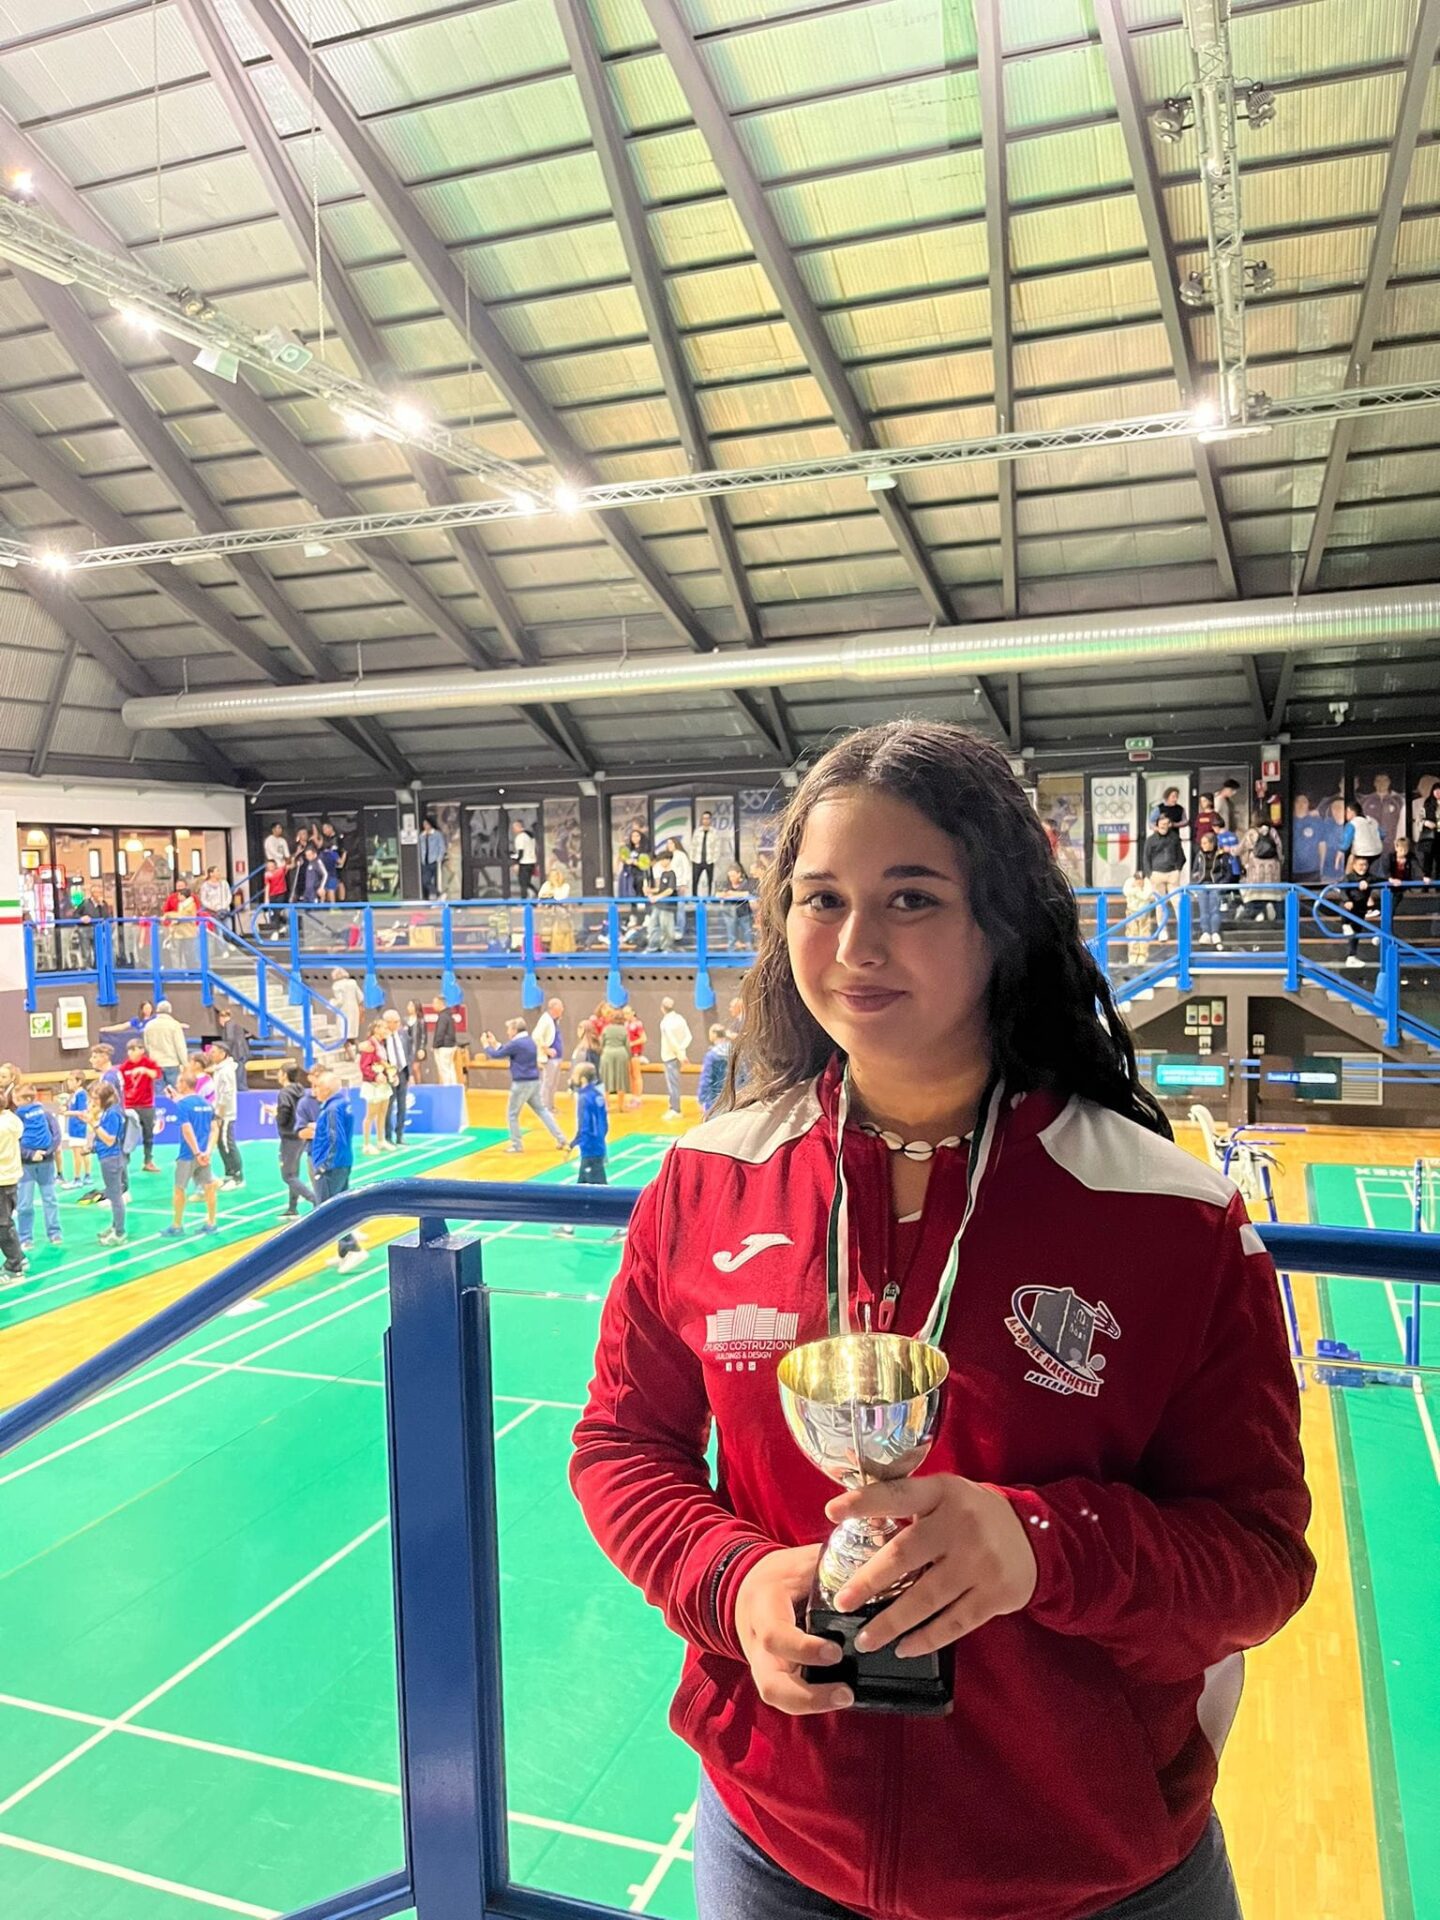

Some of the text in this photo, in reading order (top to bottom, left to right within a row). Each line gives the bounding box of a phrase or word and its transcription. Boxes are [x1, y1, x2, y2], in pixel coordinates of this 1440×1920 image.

[1094, 784, 1135, 797] CONI
[1099, 824, 1128, 832] ITALIA
[729, 1340, 796, 1351] COSTRUZIONI
[741, 1351, 747, 1359] &
[748, 1351, 772, 1359] DESIGN
[1031, 1346, 1043, 1359] LE
[1043, 1356, 1098, 1394] RACCHETTE
